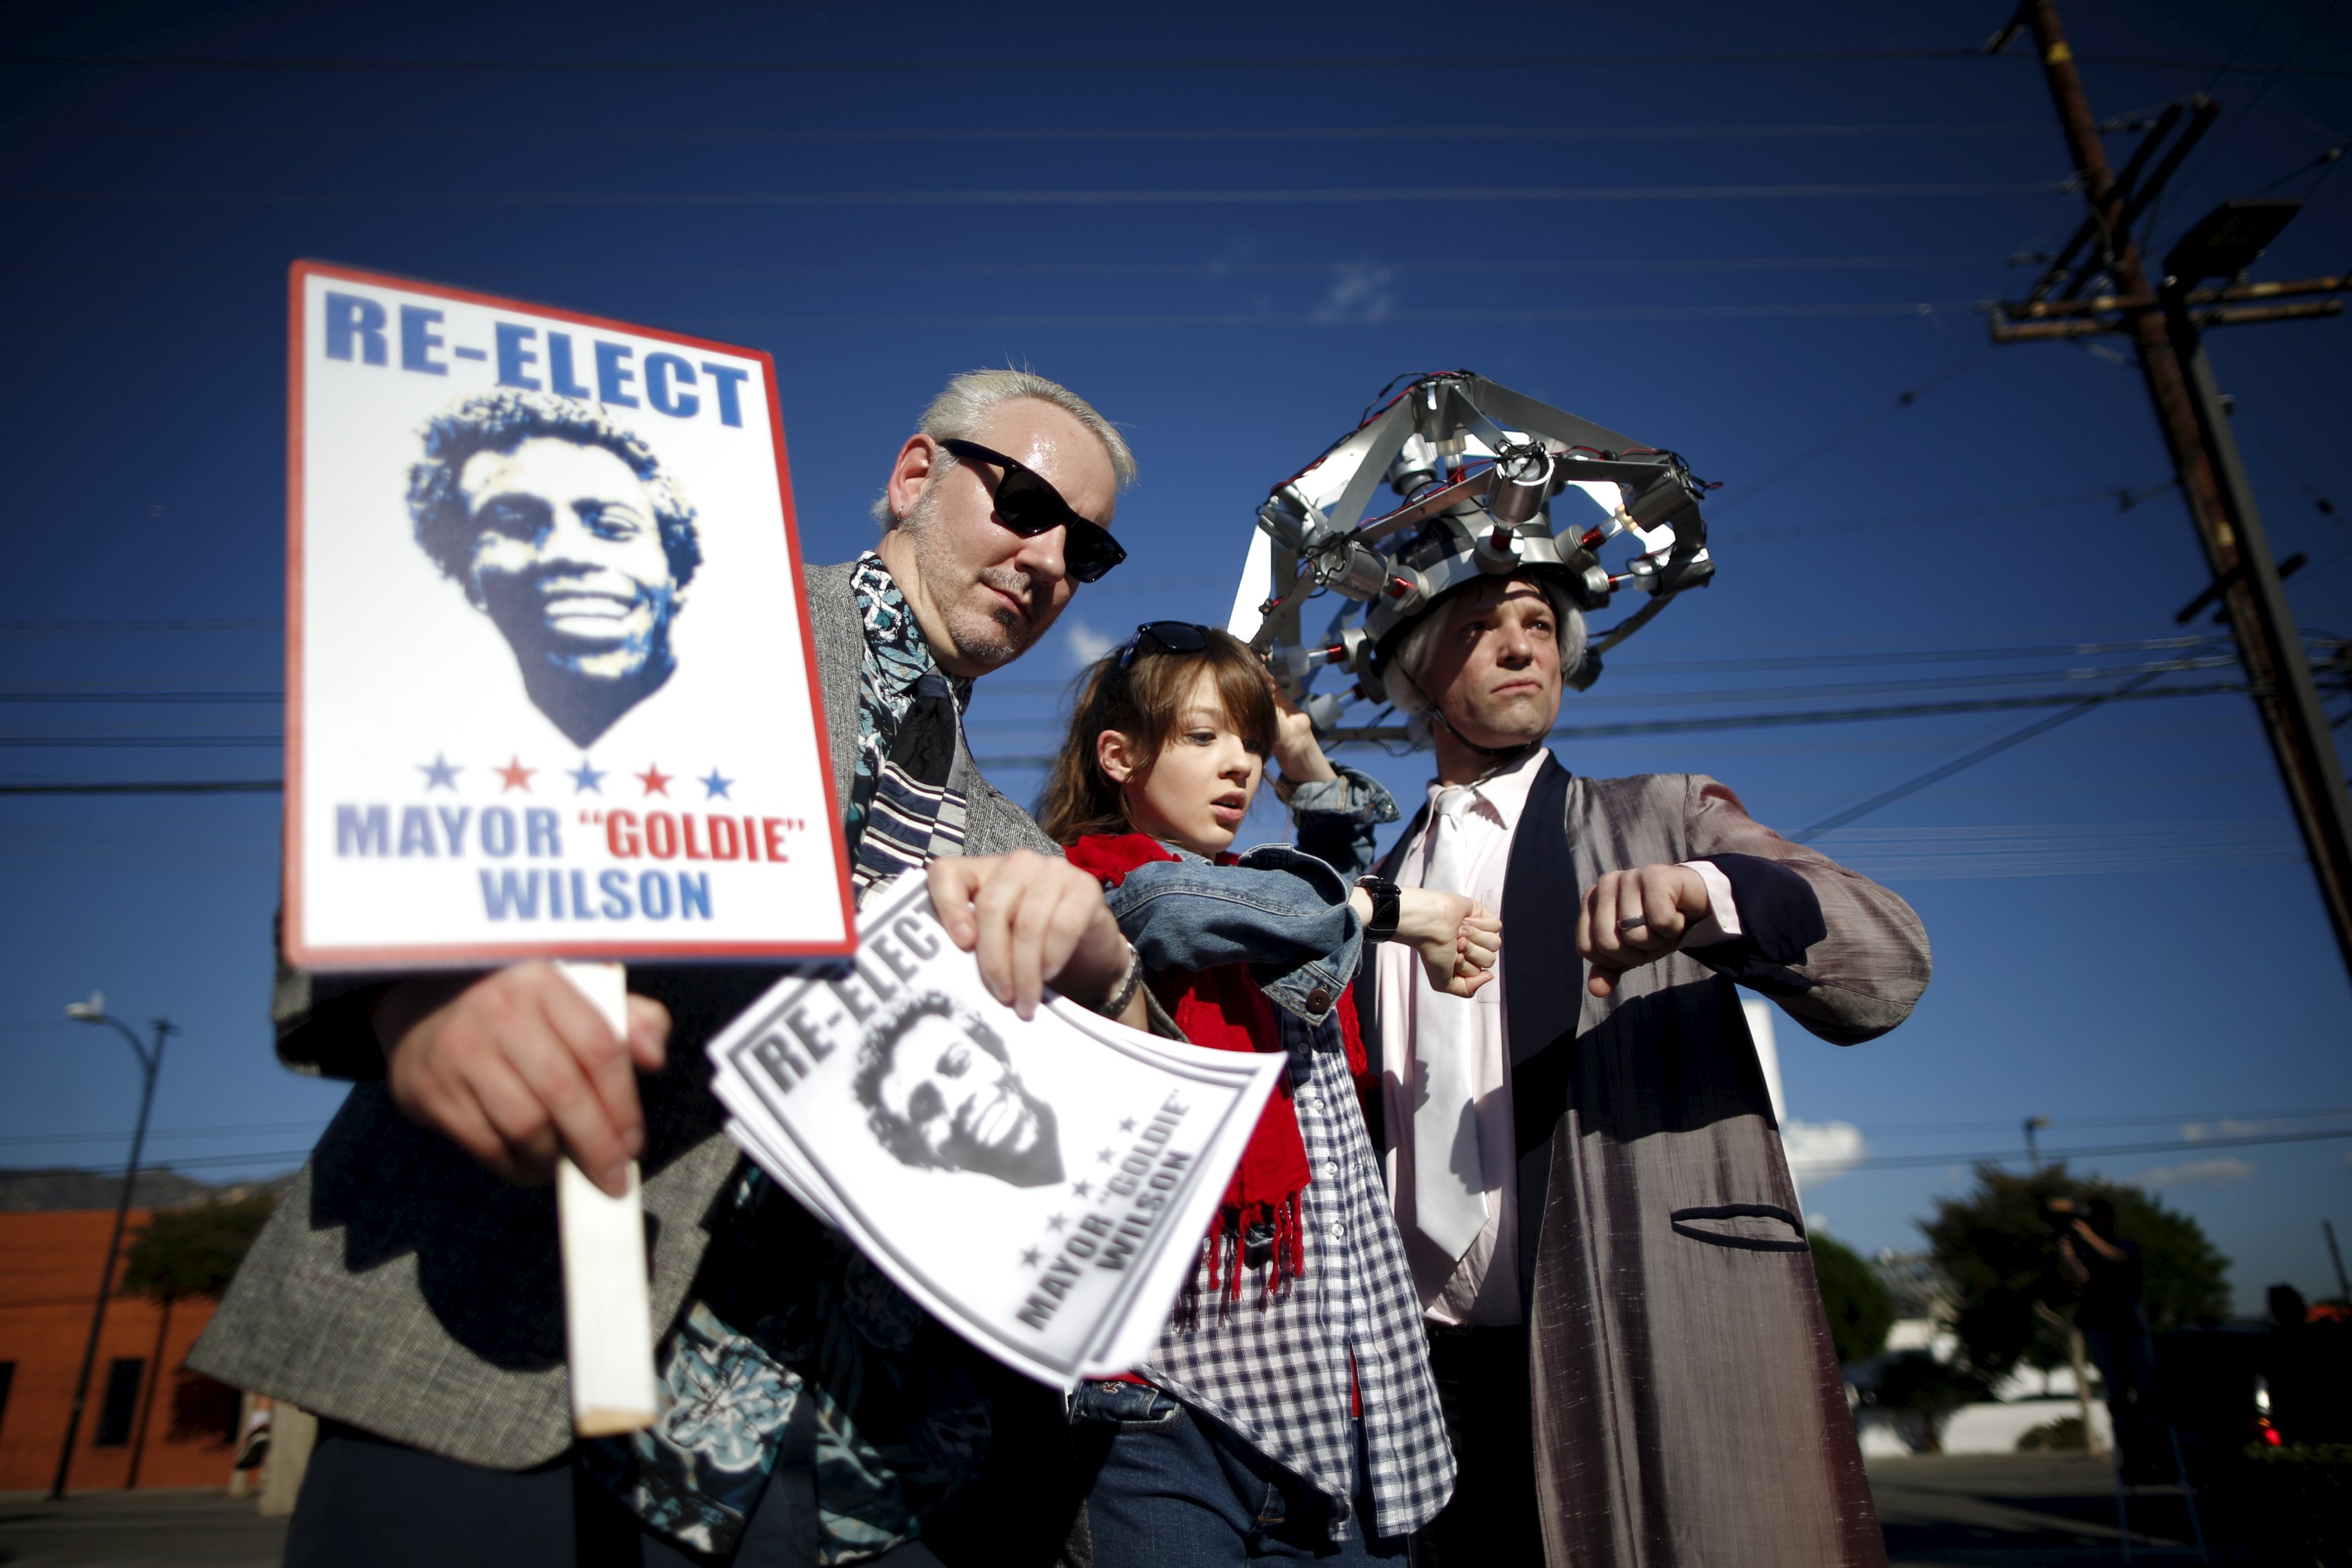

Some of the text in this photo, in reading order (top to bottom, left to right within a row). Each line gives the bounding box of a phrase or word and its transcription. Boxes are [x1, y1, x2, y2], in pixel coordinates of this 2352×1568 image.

[325, 290, 749, 429] RE-ELECT
[334, 803, 562, 859] MAYOR
[478, 869, 714, 921] WILSON
[1095, 1149, 1193, 1271] WILSON
[1015, 1212, 1114, 1331] MAYOR
